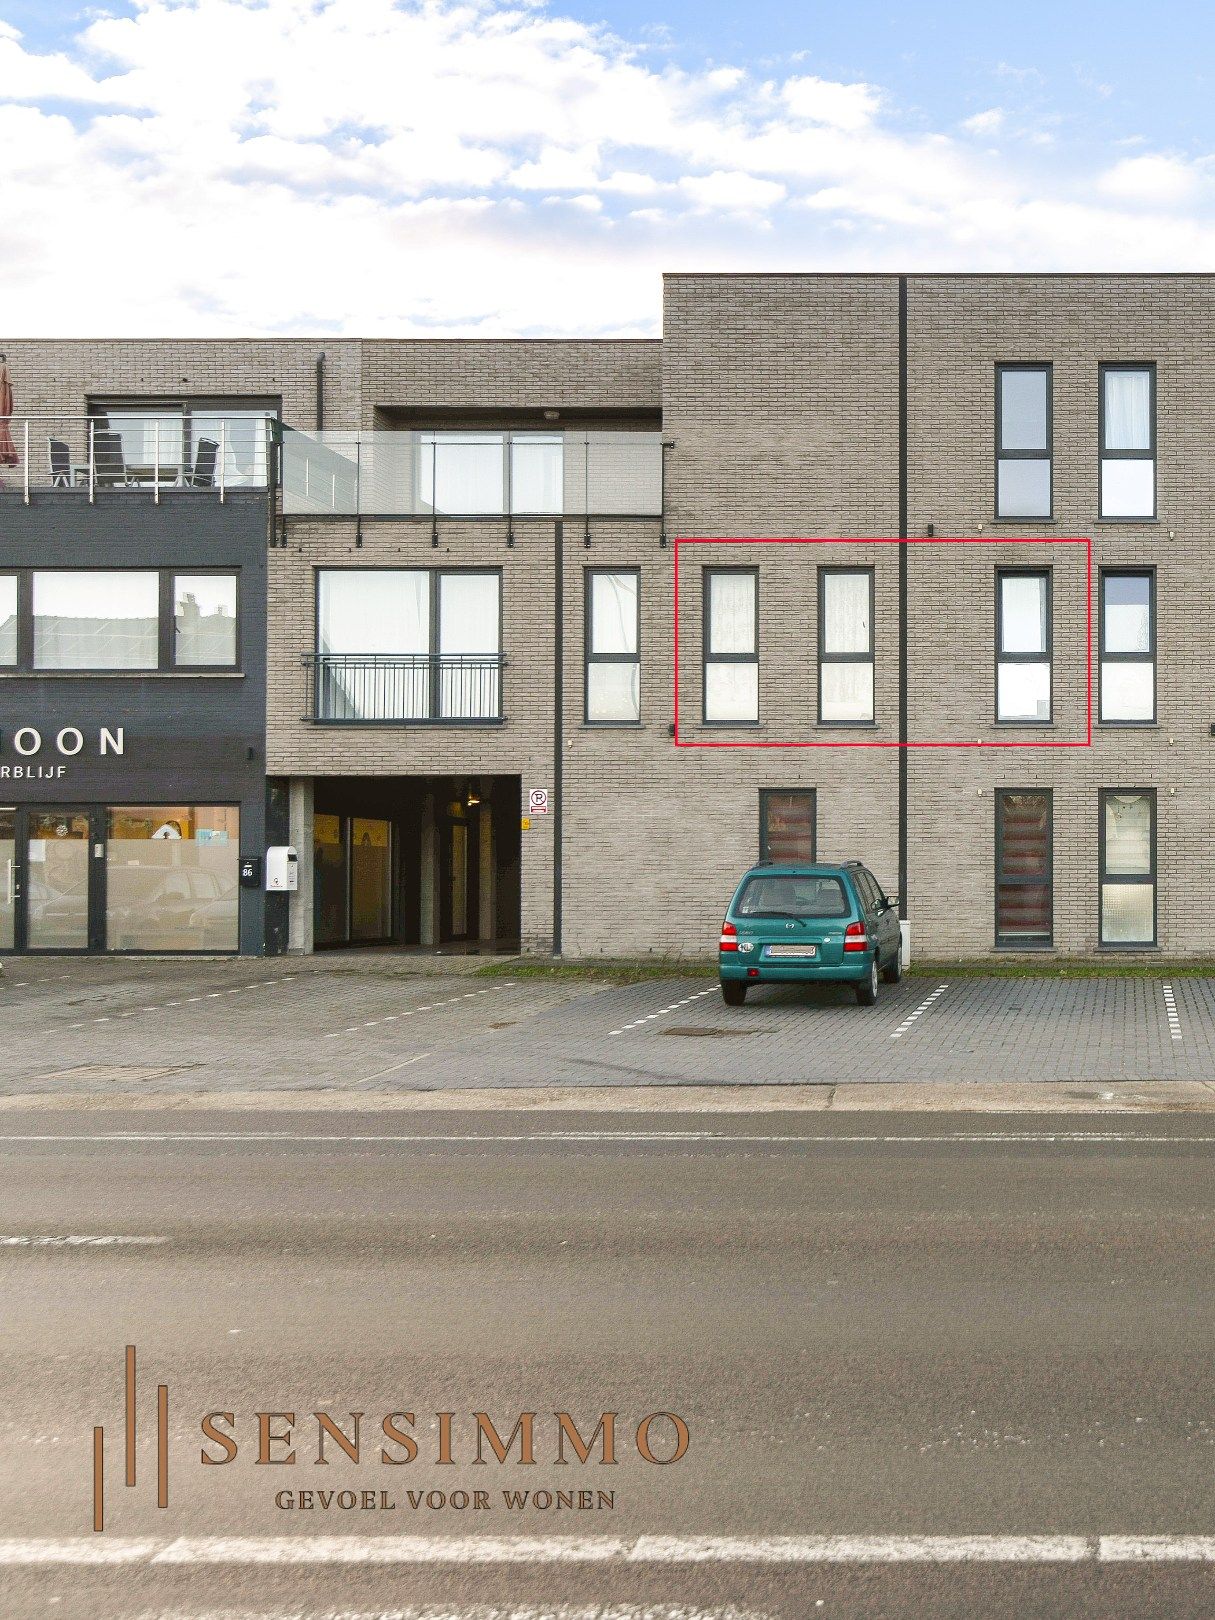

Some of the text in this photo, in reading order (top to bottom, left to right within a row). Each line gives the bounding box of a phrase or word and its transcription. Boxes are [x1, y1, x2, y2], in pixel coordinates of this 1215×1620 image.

[14, 727, 124, 755] OON
[0, 766, 67, 778] RBLIJF
[242, 868, 253, 877] 86
